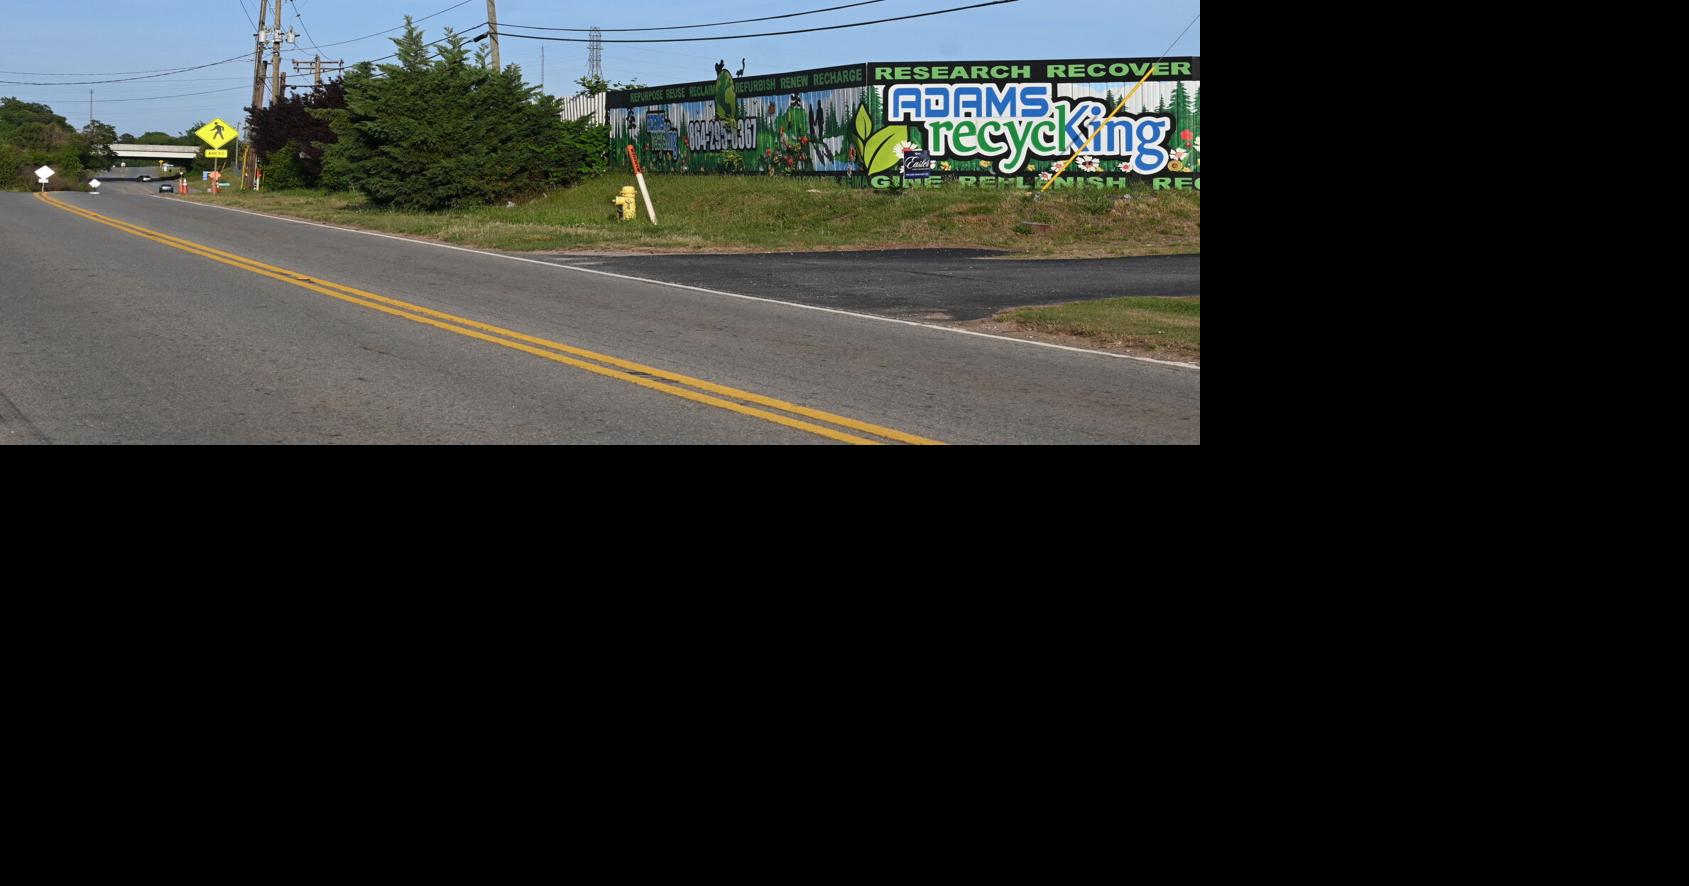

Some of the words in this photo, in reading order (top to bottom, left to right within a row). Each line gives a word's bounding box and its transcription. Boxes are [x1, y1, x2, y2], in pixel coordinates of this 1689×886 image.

[665, 87, 686, 99] REUSE
[735, 78, 776, 94] REFURBISH
[780, 74, 809, 90] RENEW
[813, 68, 863, 86] RECHARGE
[875, 65, 1031, 80] RESEARCH
[1047, 61, 1192, 78] RECOVER
[892, 86, 1050, 118] ADAMS
